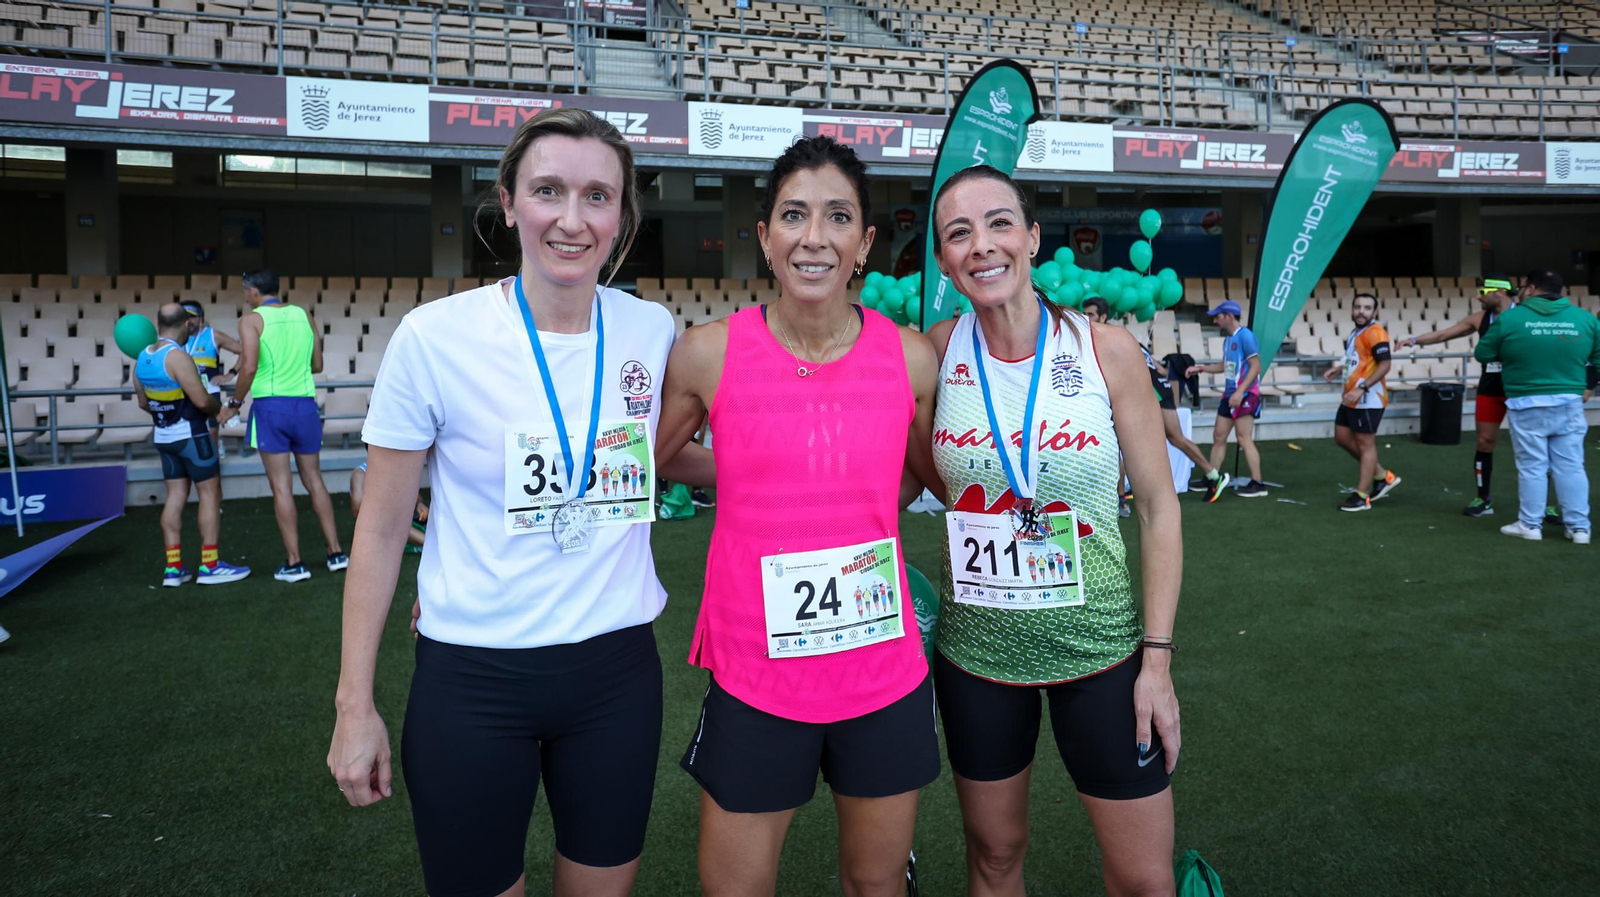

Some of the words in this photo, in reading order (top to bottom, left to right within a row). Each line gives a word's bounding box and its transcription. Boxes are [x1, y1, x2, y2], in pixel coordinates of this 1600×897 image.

[5, 65, 58, 76] ENTRENA,
[337, 101, 416, 114] Ayuntamiento
[130, 109, 179, 120] EXPLORA,
[183, 112, 234, 123] DISFRUTA,
[337, 112, 351, 120] de
[353, 112, 382, 123] Jerez
[446, 103, 542, 128] PLAY
[728, 123, 792, 134] Ayuntamiento
[728, 132, 740, 140] de
[742, 133, 765, 142] Jerez
[1051, 139, 1105, 149] Ayuntamiento
[1051, 147, 1060, 155] de
[1062, 147, 1082, 157] Jerez
[1125, 139, 1192, 159] PLAY
[1389, 151, 1450, 168] PLAY
[1268, 164, 1342, 312] ESPROHIDENT
[963, 537, 1020, 577] 211
[841, 553, 877, 576] MARATÓN
[794, 577, 842, 621] 24
